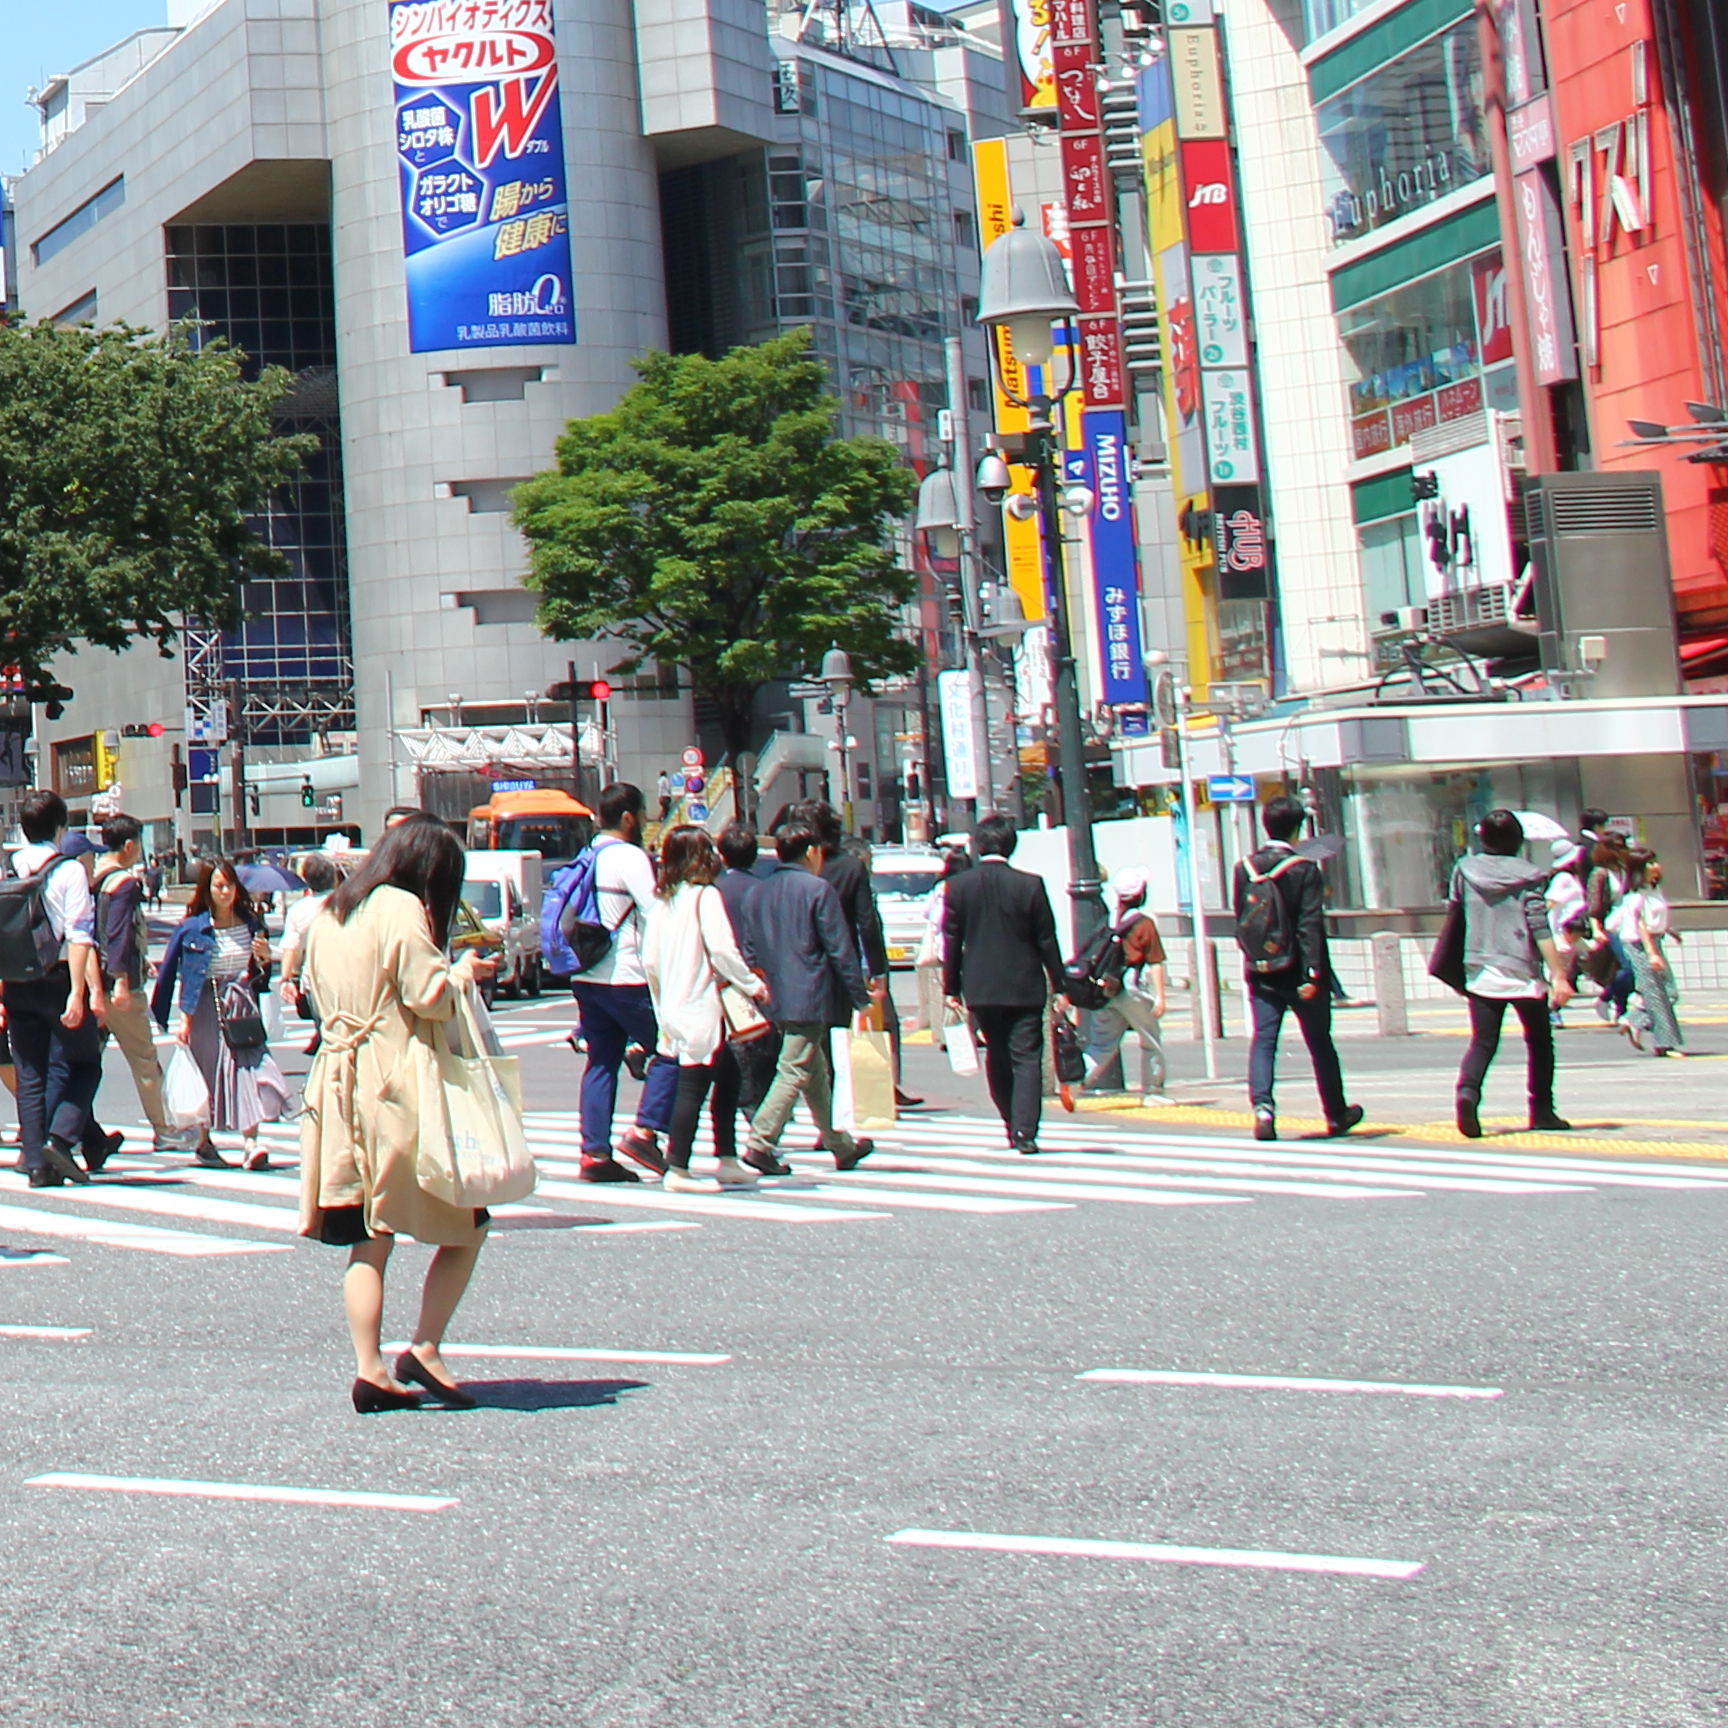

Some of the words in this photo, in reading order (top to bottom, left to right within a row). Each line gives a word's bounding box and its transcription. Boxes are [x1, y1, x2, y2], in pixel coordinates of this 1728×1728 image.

[421, 38, 528, 73] ヤクルト
[1186, 35, 1203, 118] Euphoria
[402, 107, 446, 130] 乳酸菌
[470, 62, 558, 170] W
[398, 127, 455, 152] シロタ株
[414, 149, 426, 162] と
[525, 139, 550, 155] ダブル
[1073, 140, 1088, 150] 6F
[420, 174, 474, 196] ガラクト
[490, 176, 554, 221] 腸から
[1188, 181, 1227, 208] JTB
[1331, 150, 1450, 238] Euphoria
[420, 192, 478, 216] オリゴ糖
[436, 215, 448, 228] で
[493, 211, 567, 261] 健康に
[1201, 285, 1215, 342] パーラー
[1218, 276, 1236, 333] フルーツ
[456, 323, 569, 341] 乳製品乳酸菌飲料
[1211, 400, 1228, 457] フルーツ
[1094, 434, 1120, 523] MIZUHO
[1226, 511, 1263, 571] HUB
[1105, 586, 1130, 680] みずほ銀行
[493, 781, 535, 790] SHIBUYA
